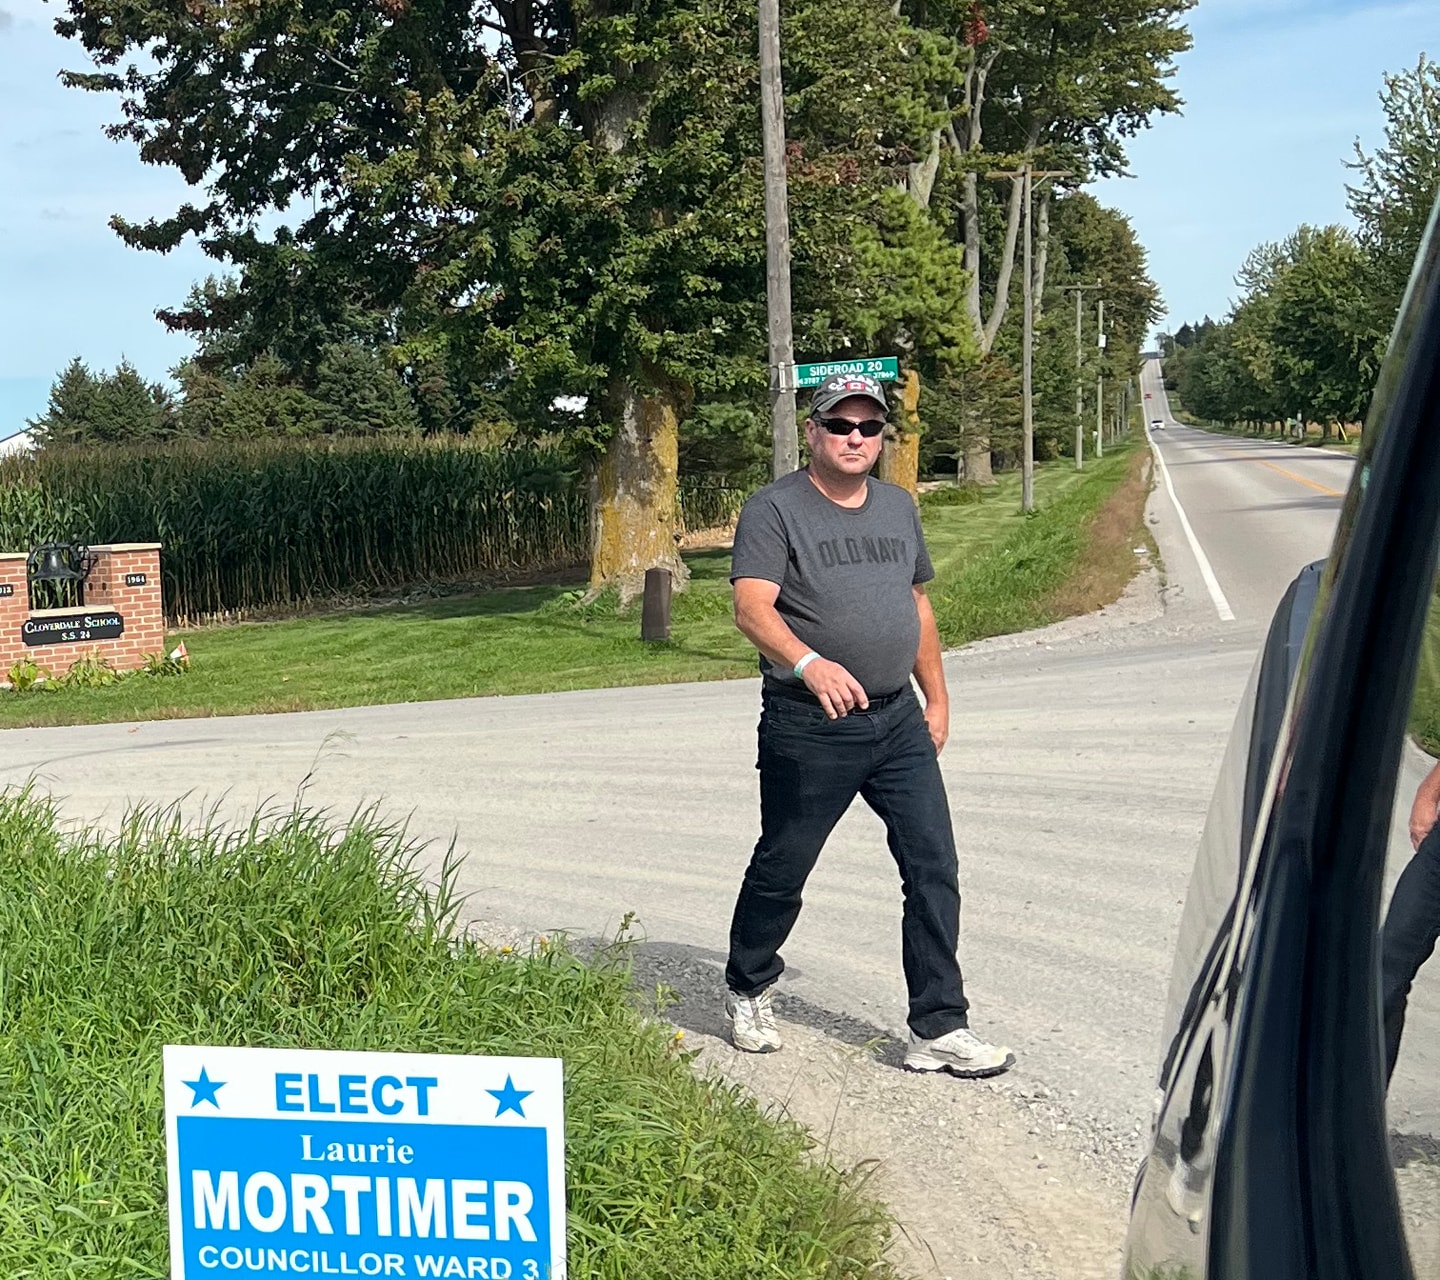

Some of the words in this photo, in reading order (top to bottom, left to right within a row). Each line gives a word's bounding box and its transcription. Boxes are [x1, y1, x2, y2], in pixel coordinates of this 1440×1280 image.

[810, 363, 864, 376] SIDEROAD
[867, 361, 882, 372] 20
[828, 374, 879, 395] CANADA
[819, 538, 862, 568] OLD
[861, 536, 908, 566] NAVY
[84, 616, 120, 628] SCHOOL
[275, 1072, 438, 1116] ELECT
[300, 1134, 415, 1165] Laurie
[191, 1169, 538, 1243] MORTIMER
[198, 1245, 406, 1276] COUNCILLOR
[414, 1254, 512, 1280] WARD
